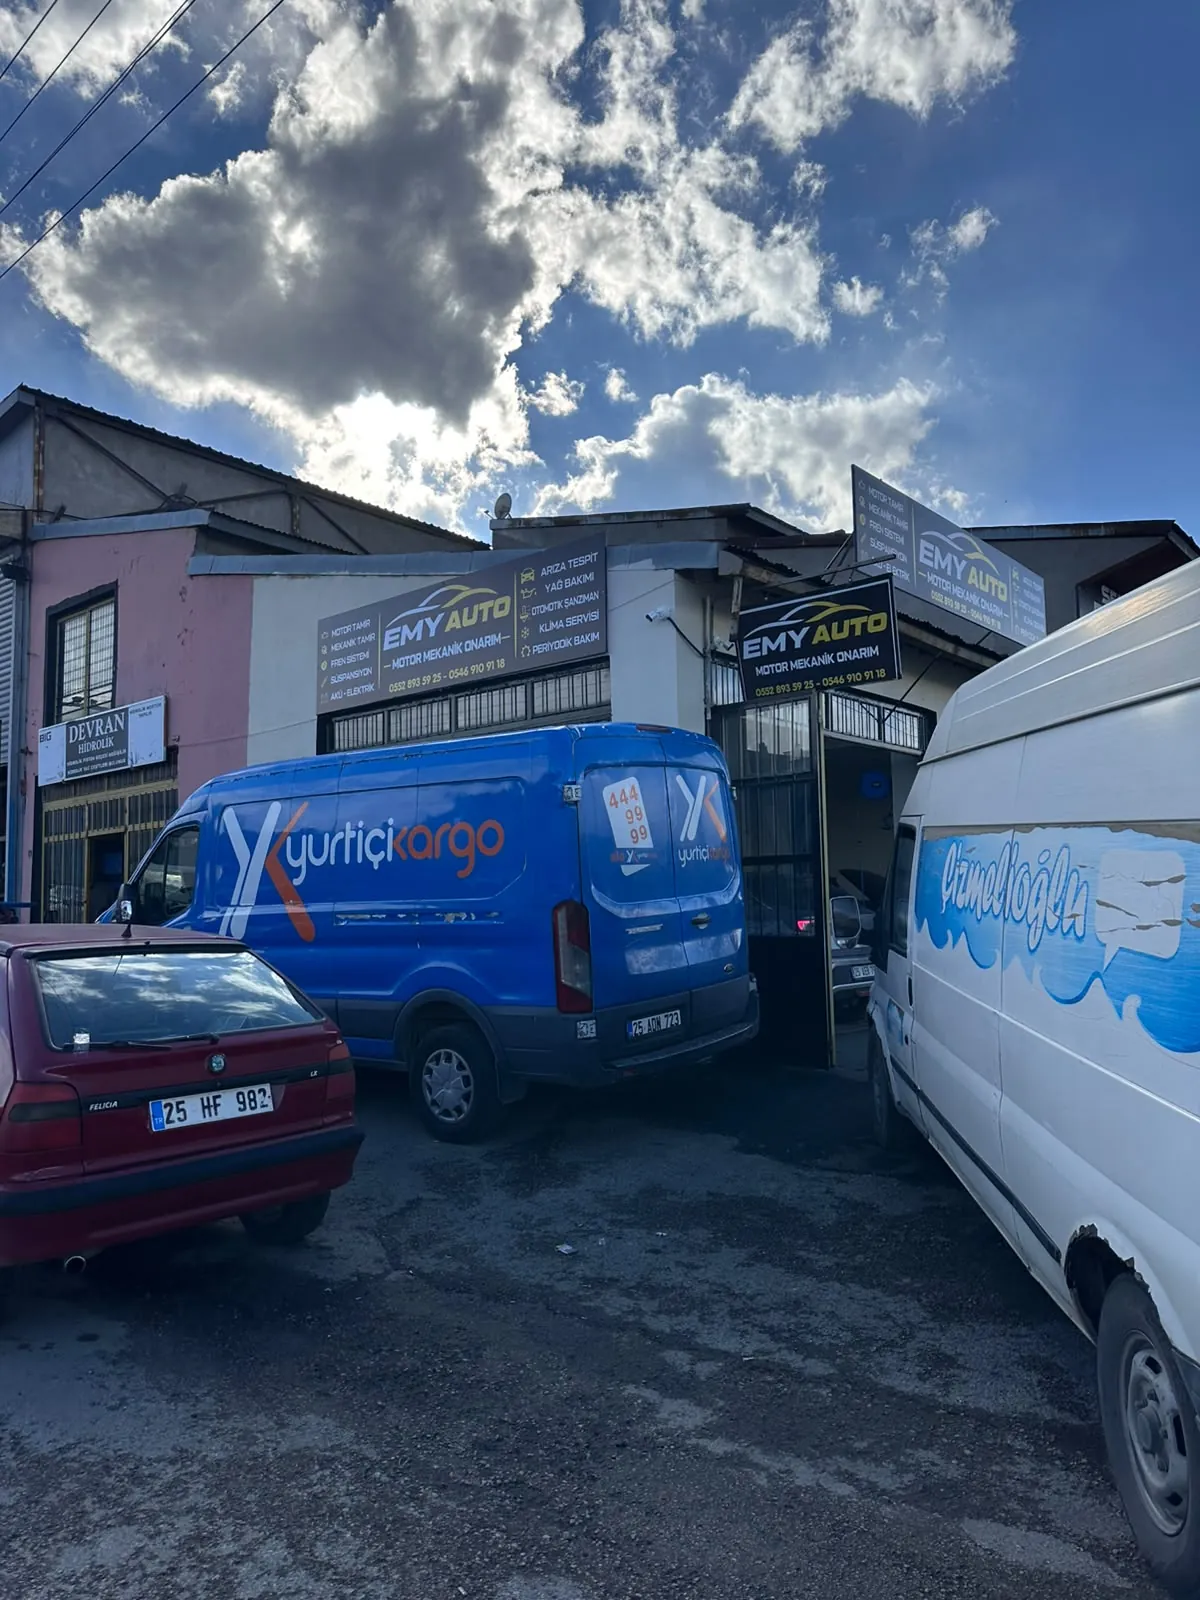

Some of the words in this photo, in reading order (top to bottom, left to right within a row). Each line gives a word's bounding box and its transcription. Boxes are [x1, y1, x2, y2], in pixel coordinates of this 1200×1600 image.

[541, 562, 566, 577] ARIZA
[920, 539, 967, 580] EMY
[967, 566, 1007, 602] AUTO
[545, 579, 563, 593] YAĞ
[564, 571, 595, 589] BAKIMI
[331, 625, 351, 638] MOTOR
[383, 611, 445, 651] EMY
[444, 595, 511, 633] AUTO
[574, 631, 600, 646] BAKIM
[743, 626, 811, 660] EMY
[811, 612, 888, 645] AUTO
[392, 652, 422, 670] MOTOR
[423, 641, 463, 661] MEKANİK
[464, 632, 502, 652] ONARIM
[755, 660, 789, 677] MOTOR
[790, 652, 835, 671] MEKANİK
[837, 645, 880, 663] ONARIM
[389, 681, 406, 693] 0552
[407, 677, 421, 689] 893
[421, 674, 431, 685] 59
[432, 672, 442, 683] 25
[449, 667, 469, 680] 0546
[470, 663, 485, 675] 910
[486, 660, 494, 671] 91
[497, 658, 505, 669] 18
[755, 686, 775, 697] 0552
[775, 684, 791, 695] 893
[792, 682, 802, 693] 59
[803, 680, 814, 691] 25
[822, 676, 845, 687] 0546
[846, 672, 862, 683] 910
[864, 670, 874, 680] 91
[875, 668, 886, 679] 18
[69, 712, 126, 744] DEVRAN
[78, 735, 115, 754] HİDROLİK
[609, 783, 639, 809] 444
[625, 806, 643, 825] 99
[630, 825, 648, 844] 99
[665, 1011, 680, 1029] 723
[89, 1101, 118, 1112] FELICIA
[163, 1100, 188, 1125] 25
[200, 1094, 222, 1119] HF
[154, 1117, 164, 1125] TR
